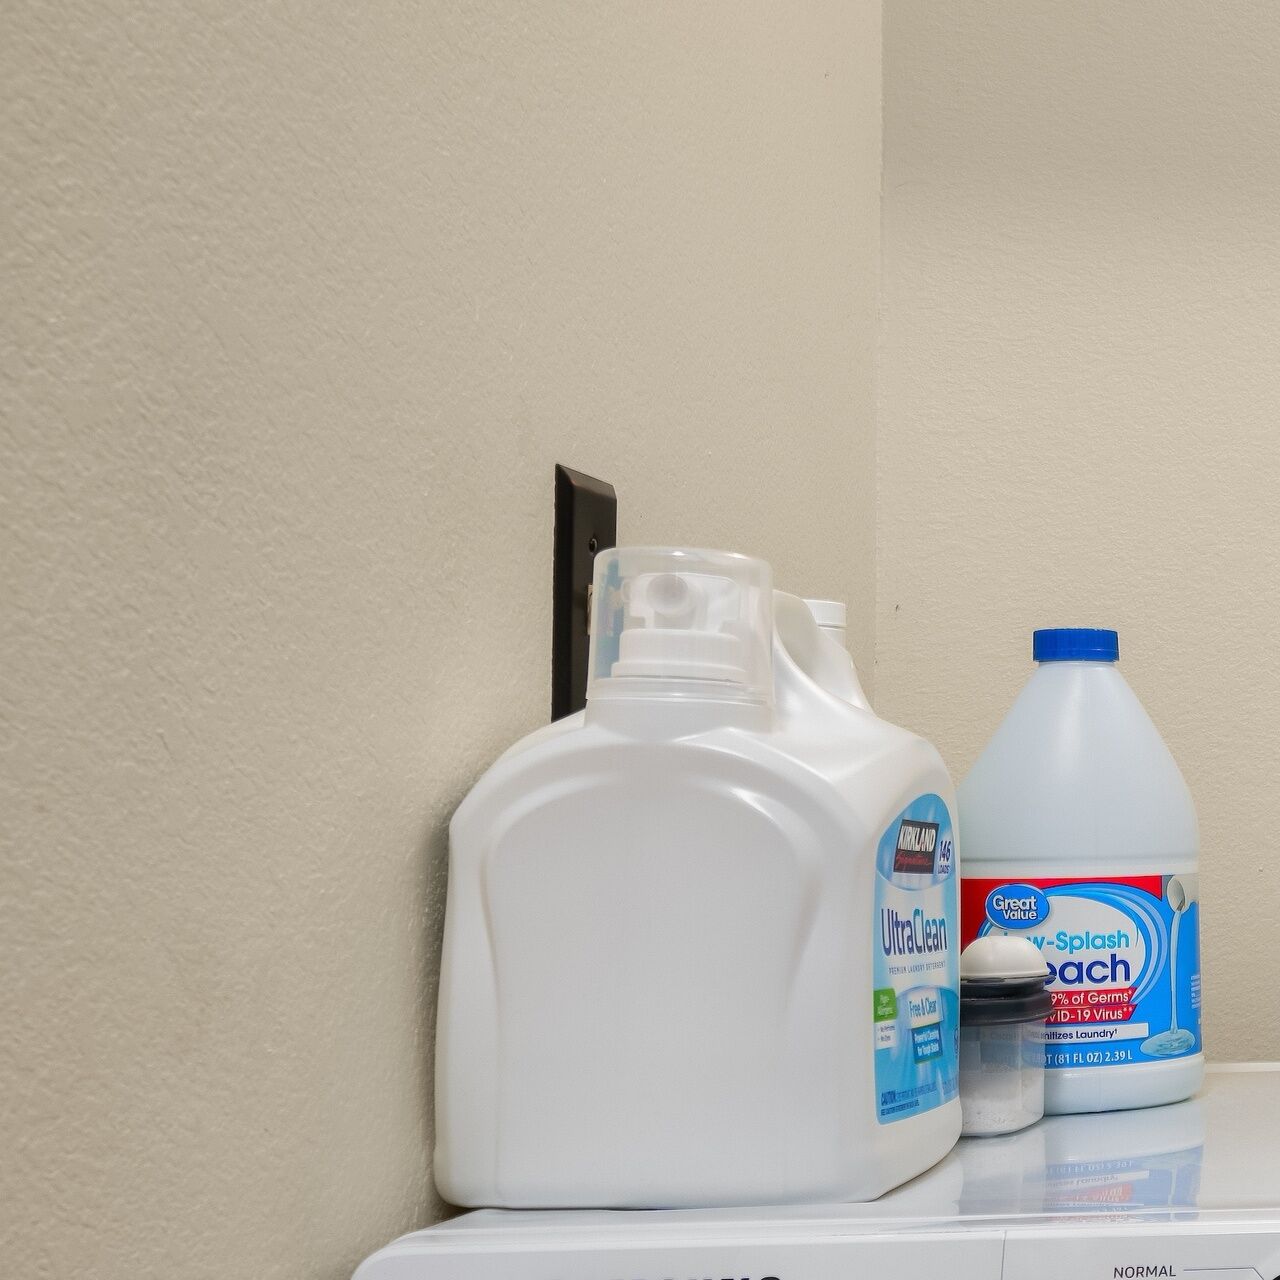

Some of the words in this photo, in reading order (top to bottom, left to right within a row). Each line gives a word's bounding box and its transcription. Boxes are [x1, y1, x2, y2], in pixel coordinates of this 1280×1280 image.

[898, 825, 936, 852] KIRKLAND
[993, 895, 1037, 911] Great
[1003, 909, 1037, 920] Value
[881, 909, 948, 956] UltraClean
[1005, 930, 1130, 954] w-Splash
[1072, 993, 1085, 1004] of
[1055, 1054, 1069, 1065] (81
[1073, 1053, 1085, 1063] FL
[1086, 1051, 1103, 1063] OZ)
[1105, 1050, 1126, 1062] 2.39
[1128, 1050, 1133, 1060] L
[1113, 1265, 1176, 1278] NORMAL
